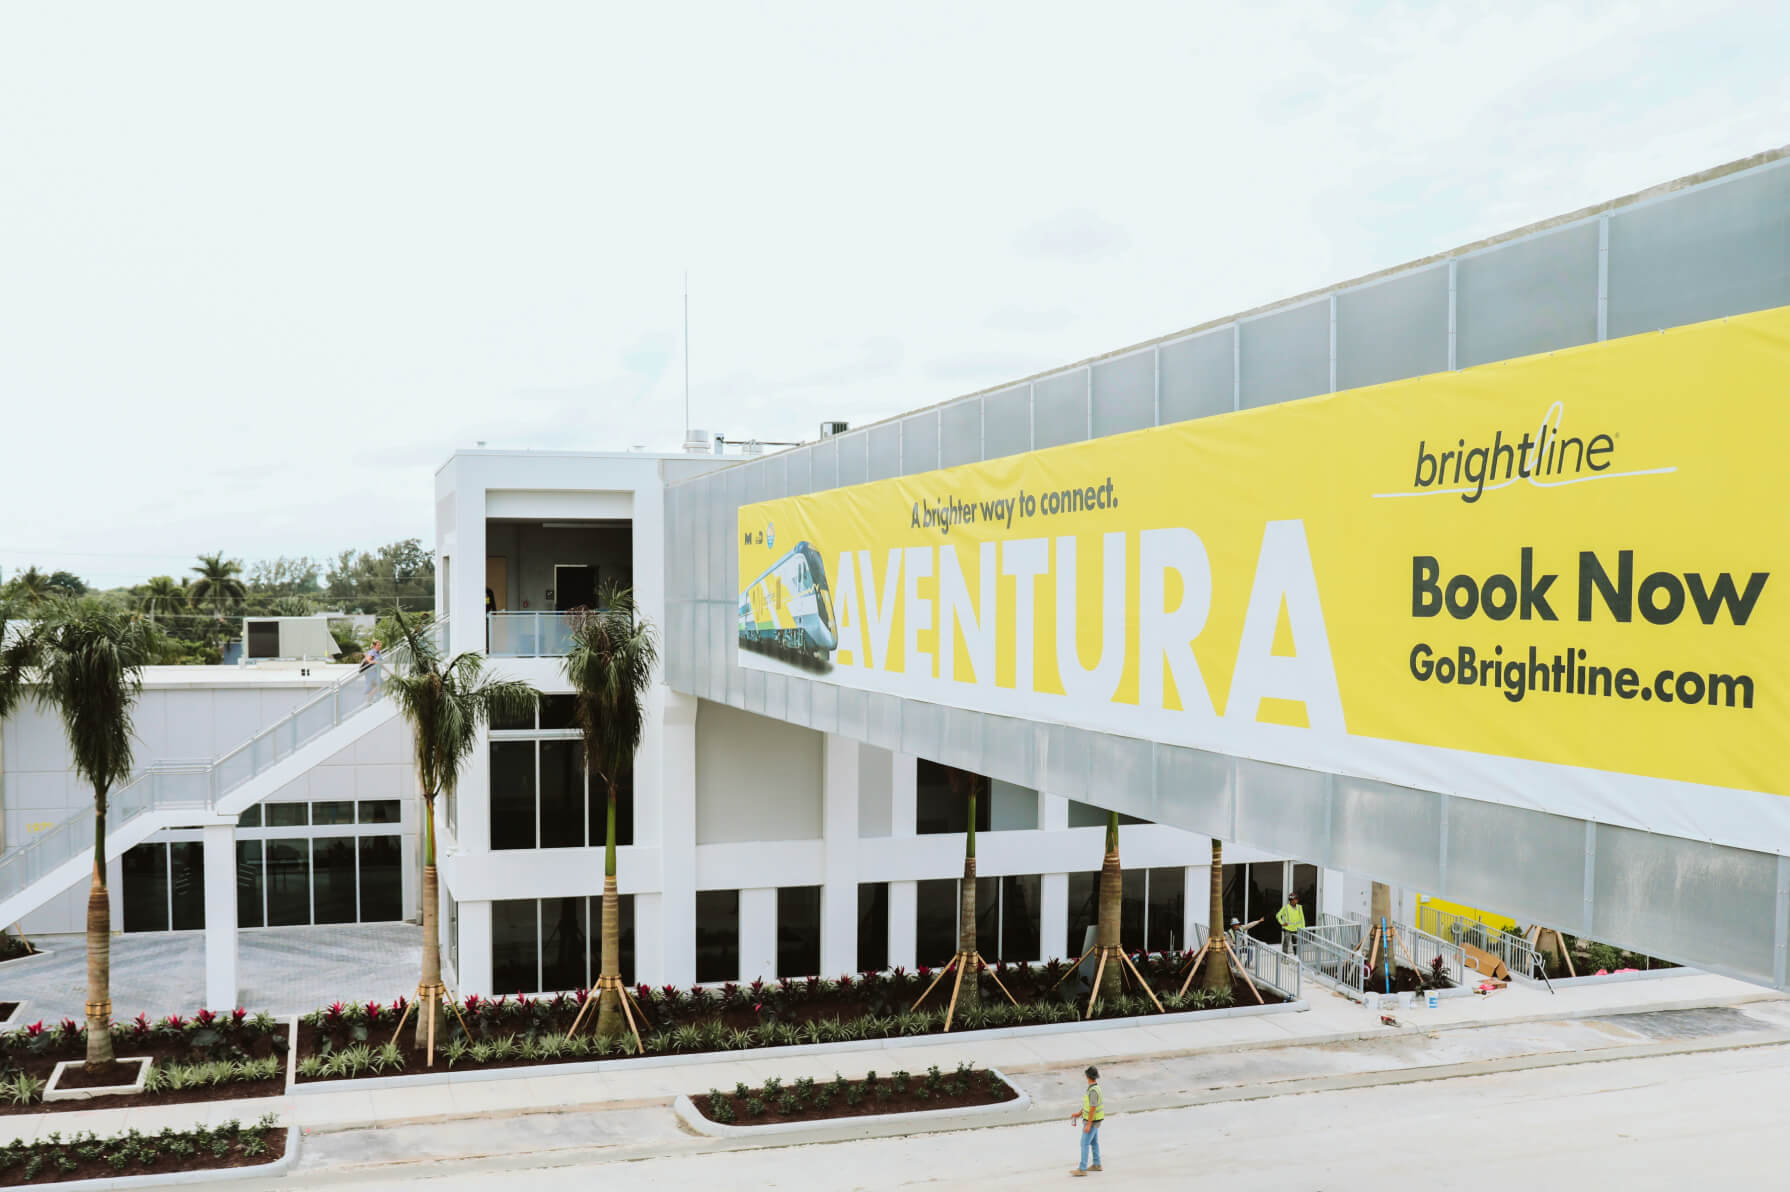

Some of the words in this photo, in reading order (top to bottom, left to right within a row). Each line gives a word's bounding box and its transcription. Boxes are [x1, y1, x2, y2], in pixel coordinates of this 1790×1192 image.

[1414, 424, 1615, 503] brightline
[911, 502, 921, 529] A
[923, 495, 977, 535] brighter
[980, 497, 1016, 530] way
[1019, 489, 1036, 518] to
[1040, 477, 1119, 516] connect.
[1411, 546, 1560, 621] Book
[1577, 549, 1771, 626] Now
[835, 518, 1348, 735] AVENTURA
[1409, 643, 1755, 709] GoBrightline.com
